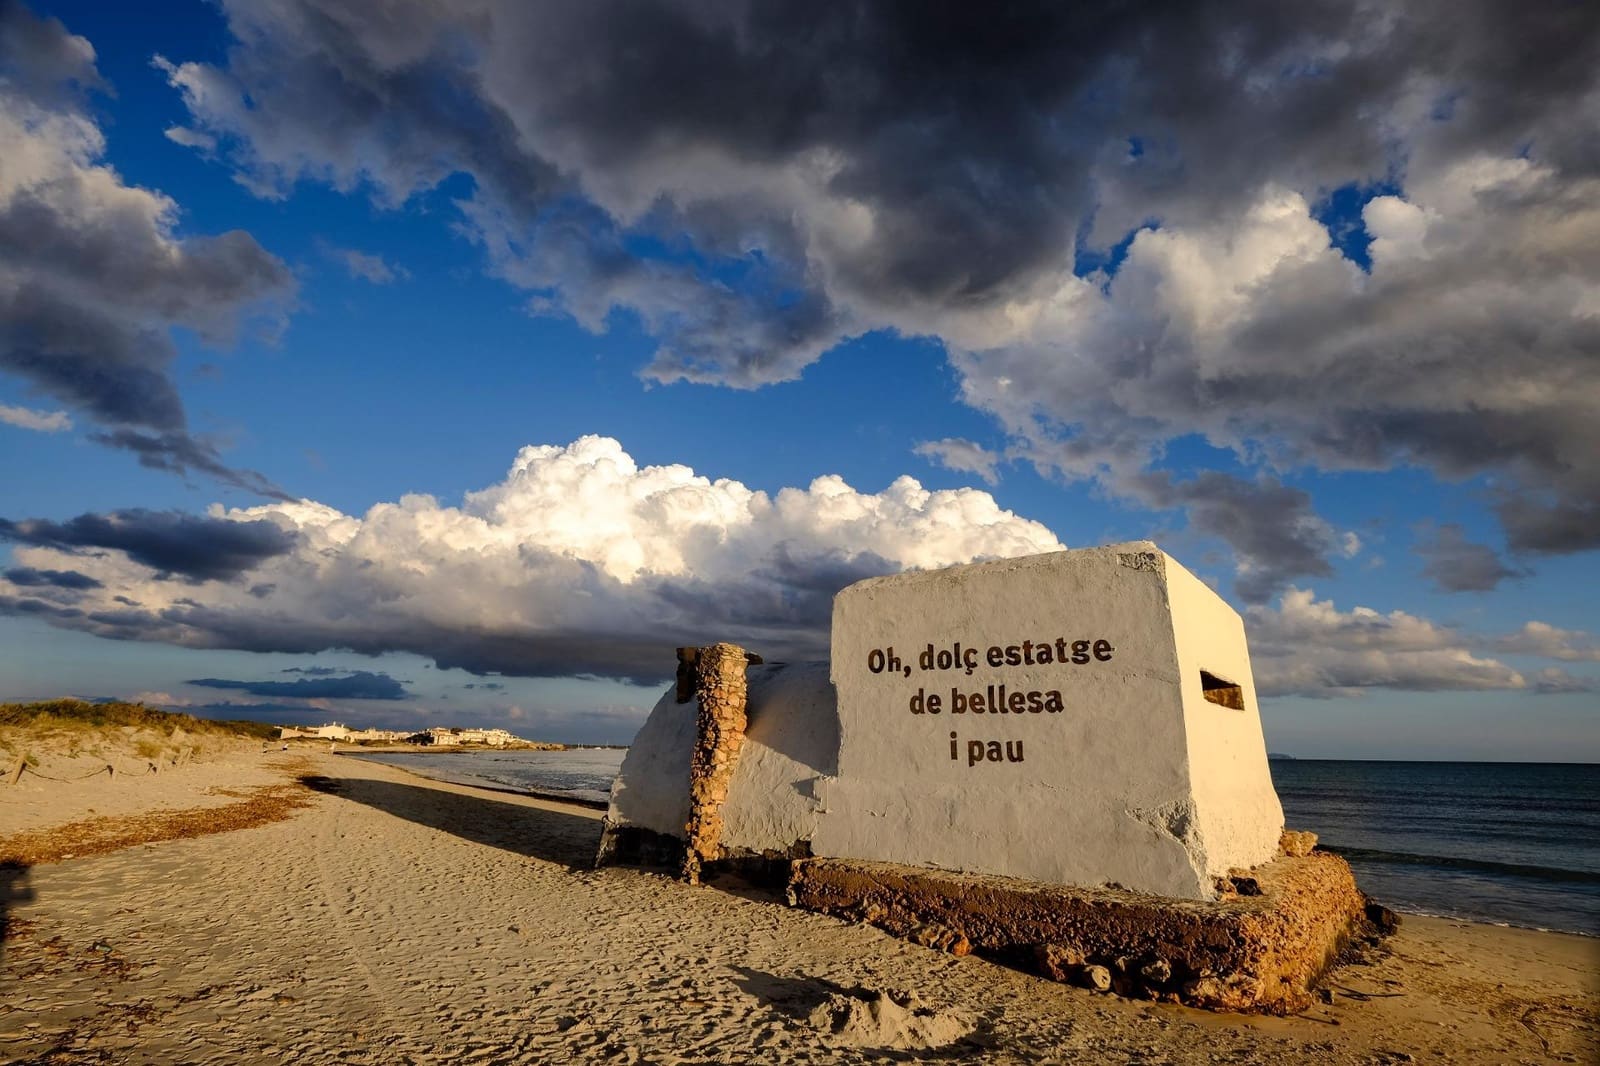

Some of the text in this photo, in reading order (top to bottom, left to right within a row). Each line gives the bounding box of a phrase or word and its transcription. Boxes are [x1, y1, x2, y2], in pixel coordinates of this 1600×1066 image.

[867, 637, 1113, 678] Oh, dolç estatge
[909, 684, 1065, 715] de bellesa
[949, 731, 1025, 767] i pau
